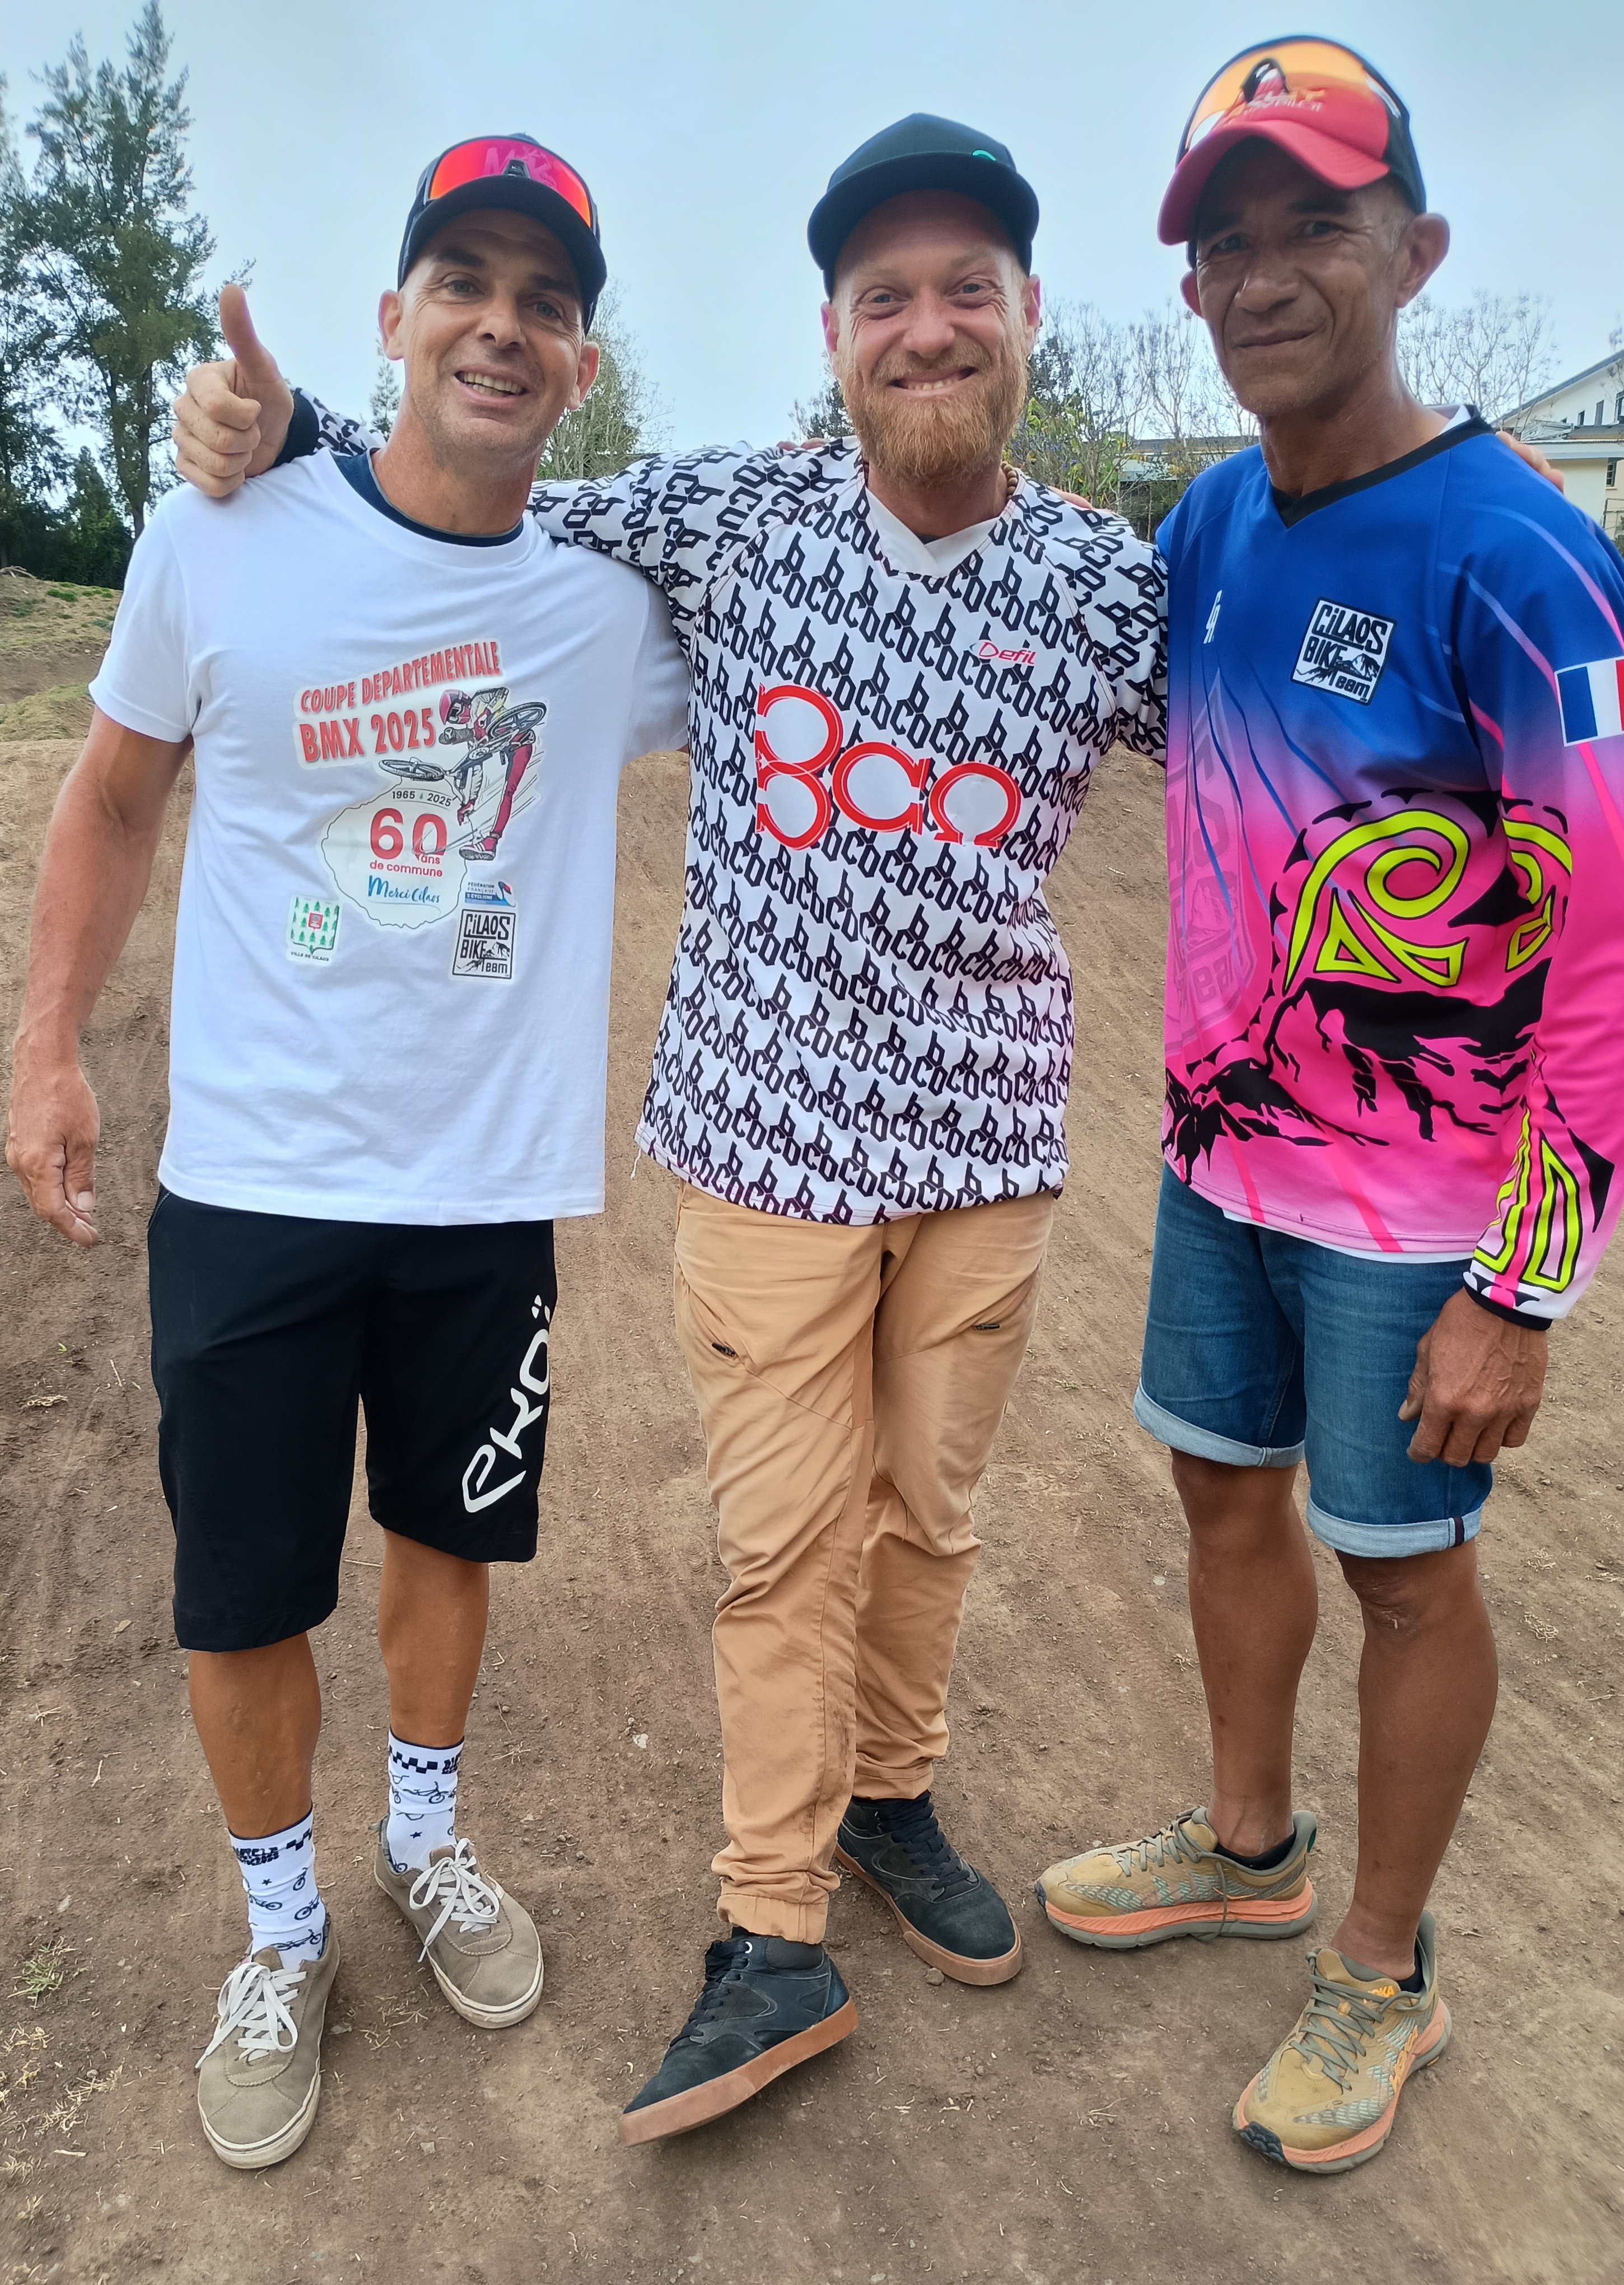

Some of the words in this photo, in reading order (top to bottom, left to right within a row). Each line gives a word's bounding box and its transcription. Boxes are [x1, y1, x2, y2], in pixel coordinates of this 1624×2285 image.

[1303, 636, 1348, 670] BIKE
[300, 682, 355, 715] COUPE
[362, 641, 500, 703] DEPARTEMENTALE
[299, 717, 364, 762] BMX
[370, 708, 436, 754] 2025
[392, 791, 416, 799] 1965
[427, 793, 452, 806] 2025
[370, 808, 447, 860] 60
[370, 860, 384, 870] de
[387, 864, 442, 877] commune
[421, 855, 440, 864] ans
[368, 875, 411, 898] Merci
[460, 939, 487, 959] BIKE
